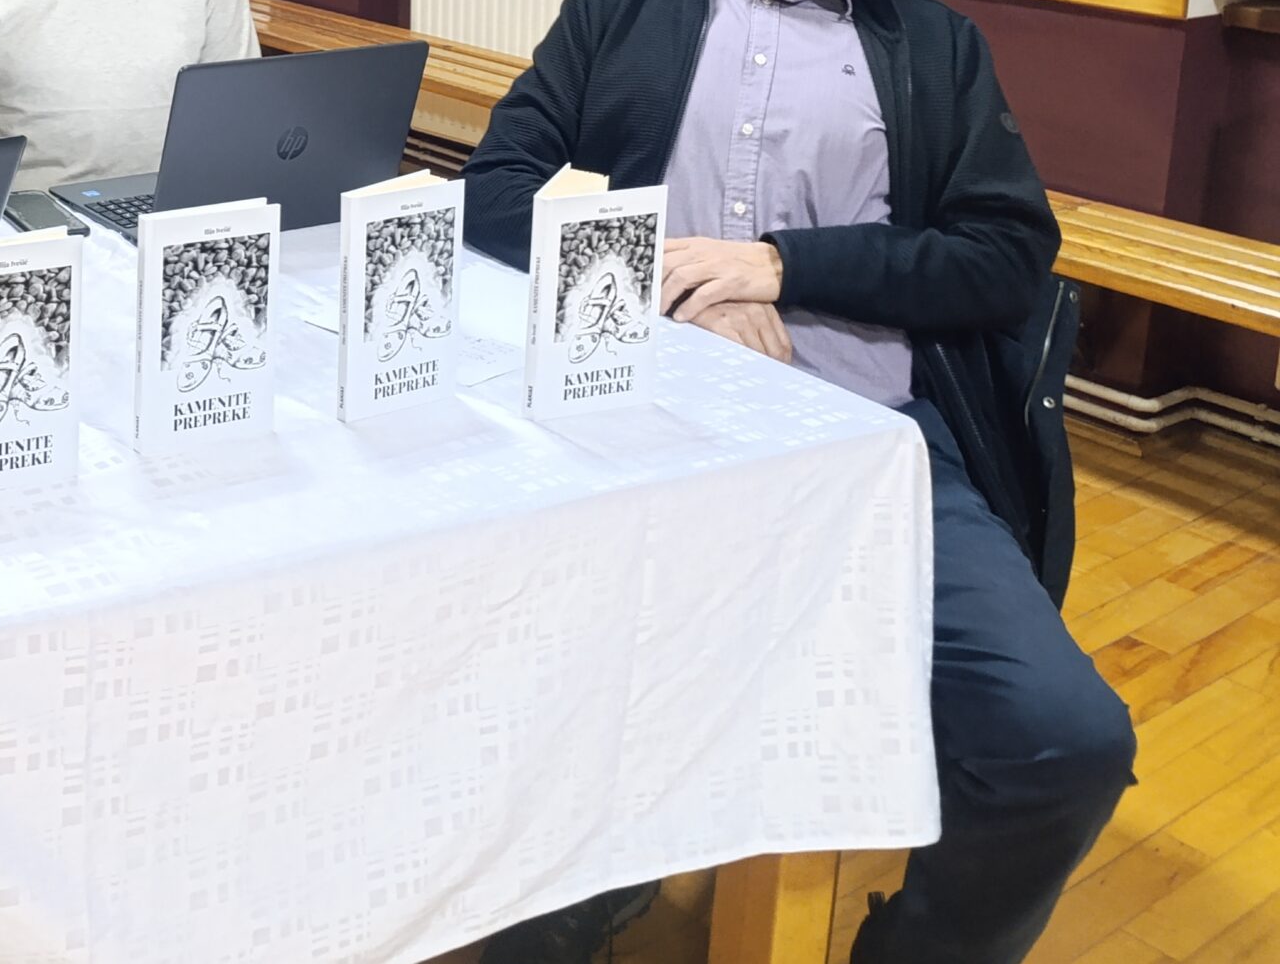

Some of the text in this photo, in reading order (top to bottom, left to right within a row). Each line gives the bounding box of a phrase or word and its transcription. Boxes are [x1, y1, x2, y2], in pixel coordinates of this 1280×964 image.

[374, 359, 439, 386] KAMENITE
[564, 365, 635, 386] KAMENITE
[374, 374, 439, 400] PREPREKE
[563, 380, 633, 401] PREPREKE
[173, 391, 251, 417] KAMENITE
[173, 406, 251, 432] PREPREKE
